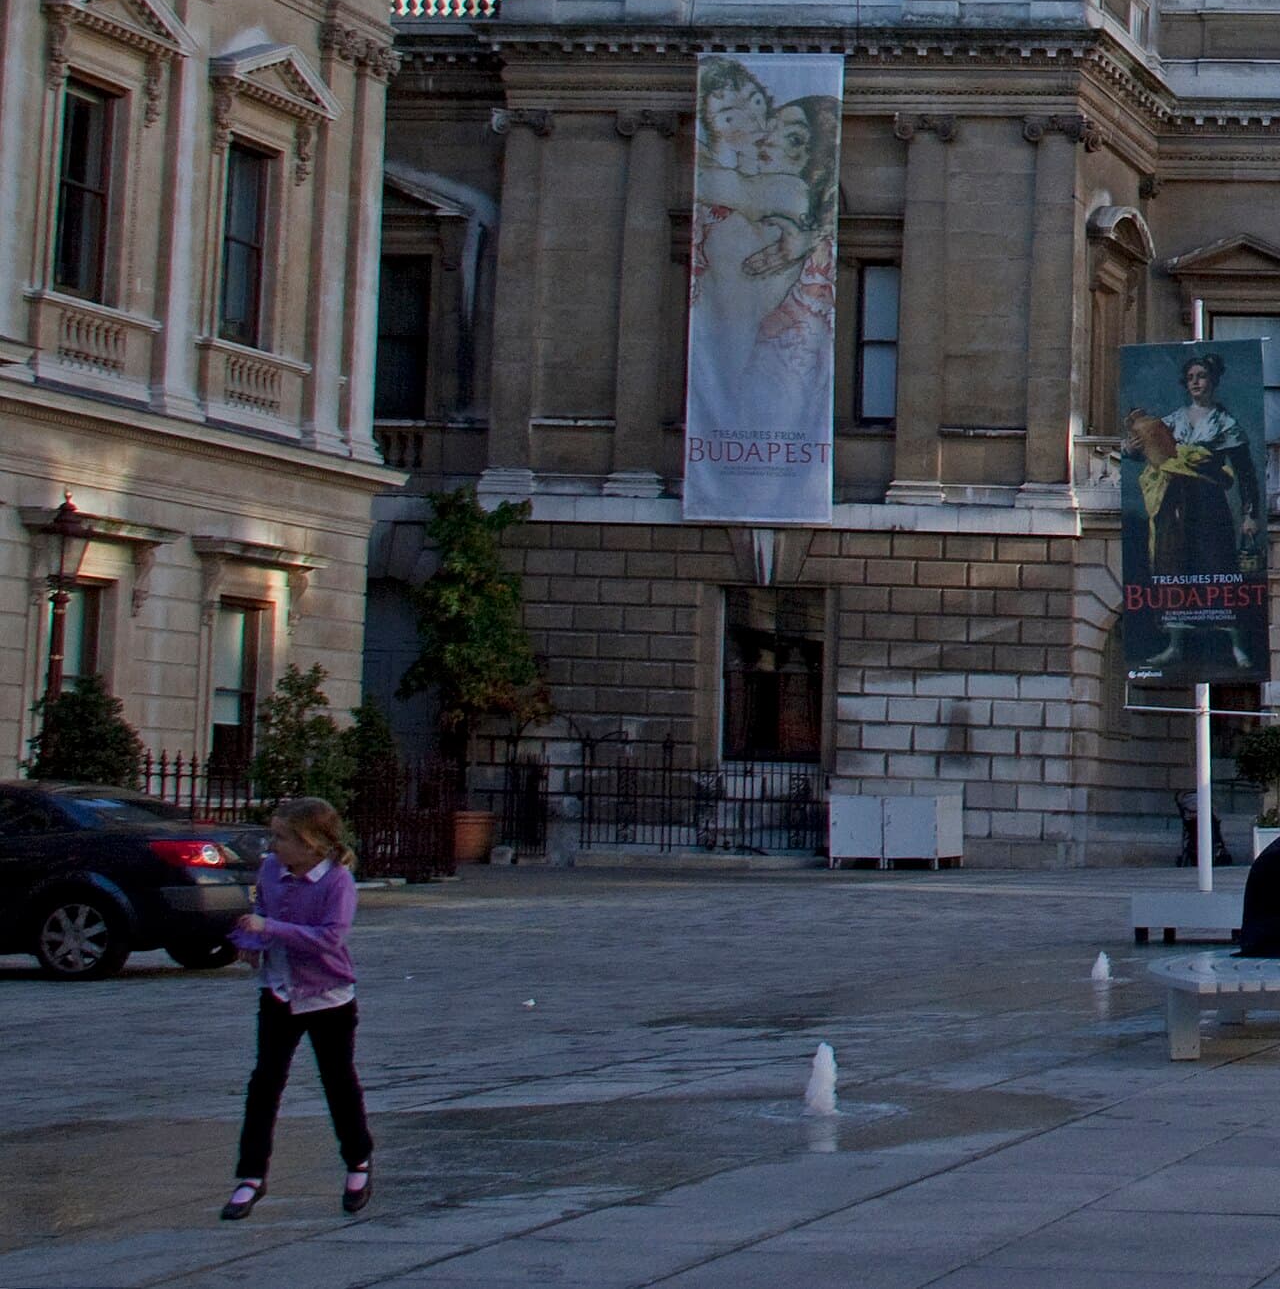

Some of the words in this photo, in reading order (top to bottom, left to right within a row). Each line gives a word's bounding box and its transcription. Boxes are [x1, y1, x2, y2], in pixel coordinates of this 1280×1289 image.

[712, 429, 773, 440] TREASURES
[774, 430, 806, 440] FROM
[688, 437, 831, 463] BUDAPEST
[1152, 574, 1211, 585] TREASURES
[1213, 573, 1243, 584] FROM
[1125, 584, 1267, 610] BUDAPEST
